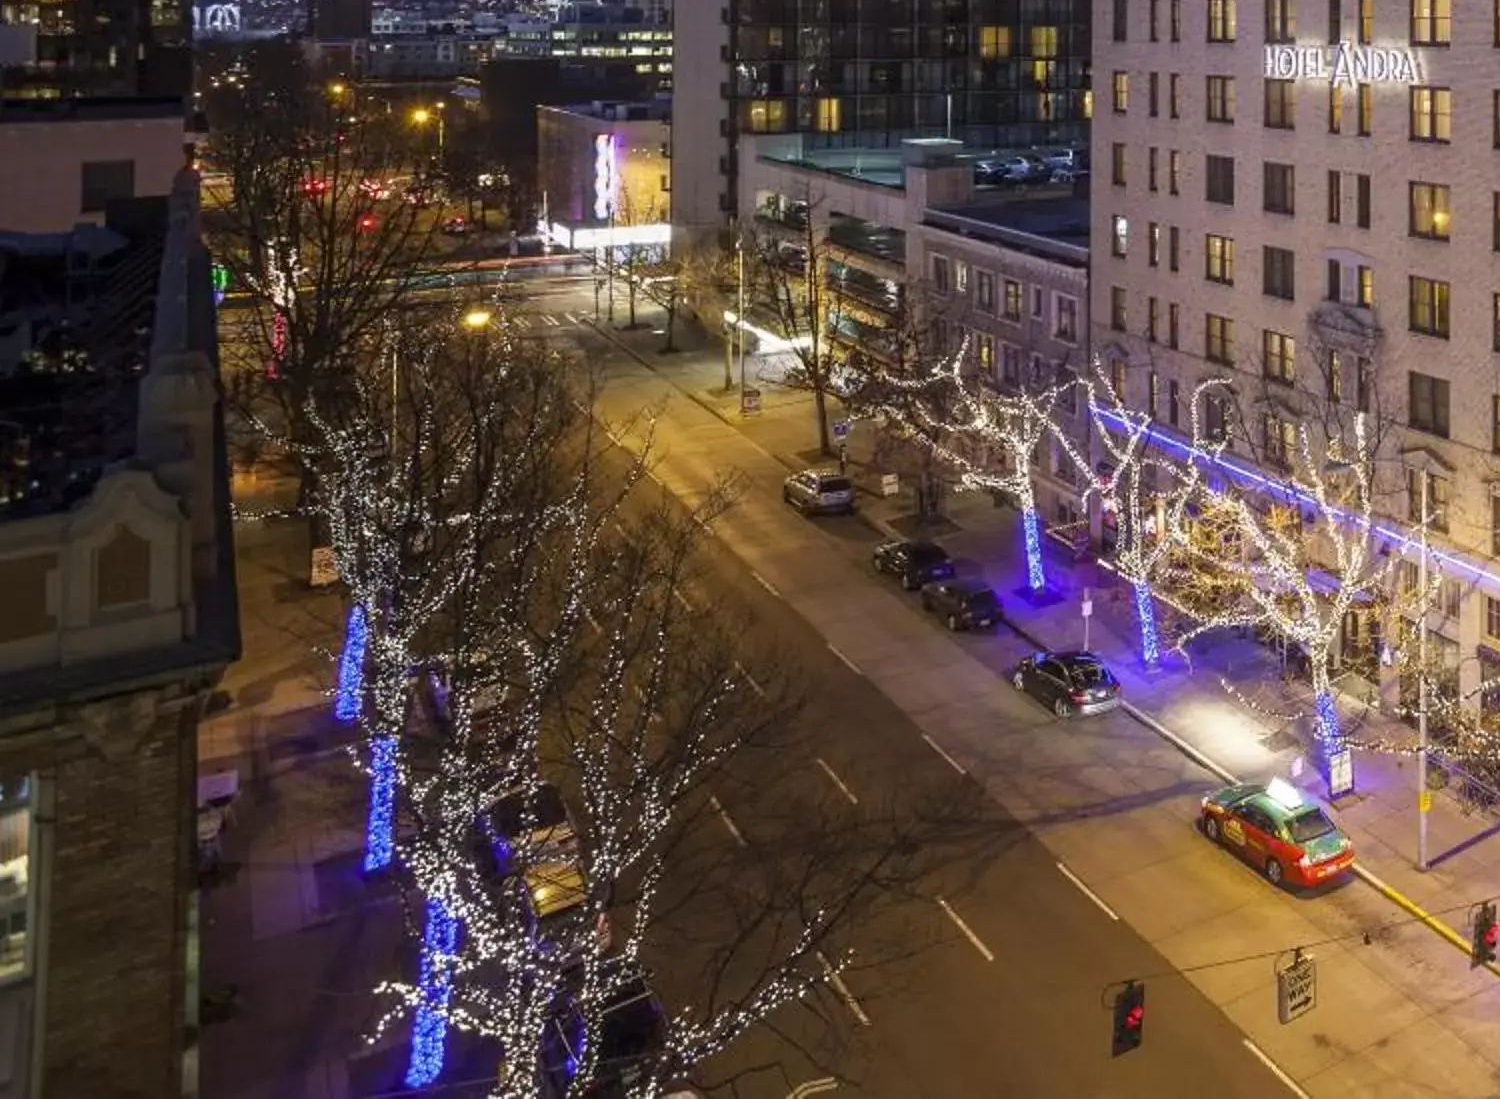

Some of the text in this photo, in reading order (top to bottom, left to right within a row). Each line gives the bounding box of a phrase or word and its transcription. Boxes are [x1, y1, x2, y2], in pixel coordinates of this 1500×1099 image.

[1264, 40, 1420, 89] HOTEL ANDRA
[1287, 967, 1312, 989] ONE
[1288, 981, 1312, 1002] WAY
